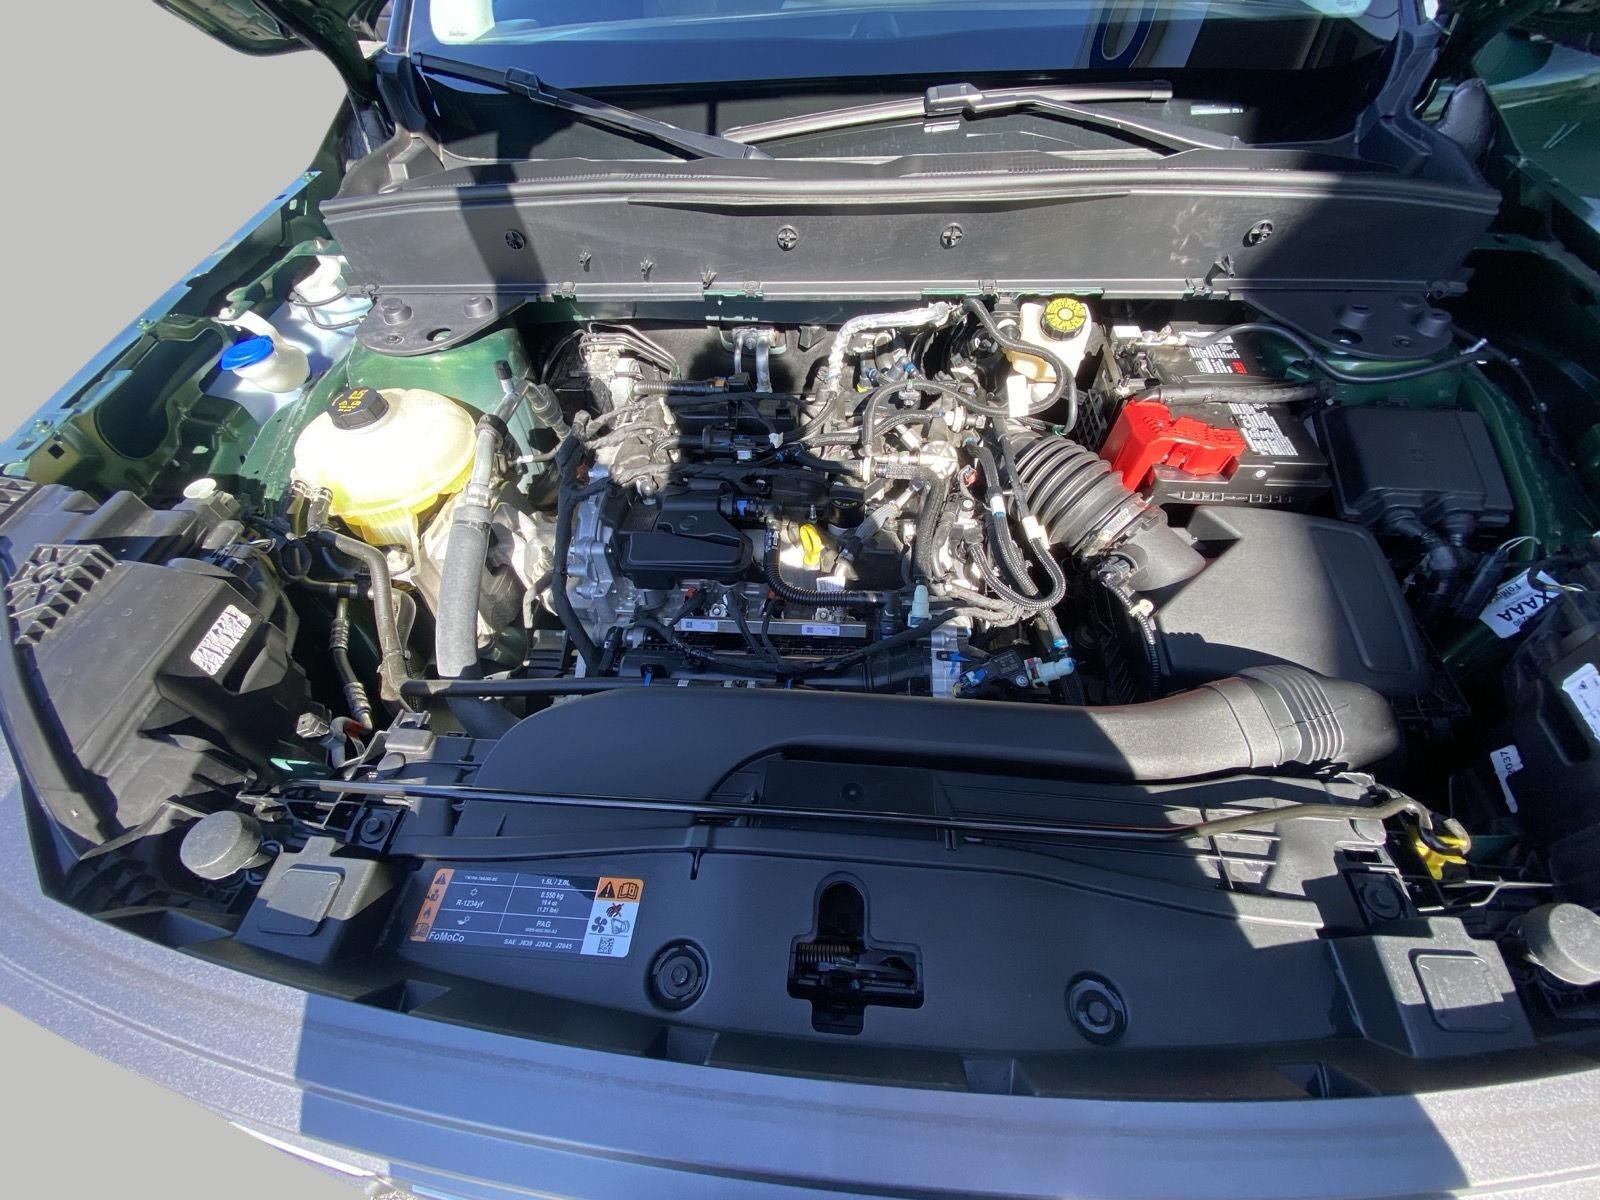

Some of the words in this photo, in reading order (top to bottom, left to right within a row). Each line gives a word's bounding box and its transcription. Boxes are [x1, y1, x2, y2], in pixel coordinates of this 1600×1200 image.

[1496, 588, 1552, 622] XAAA
[541, 878, 553, 886] 1.5L
[558, 878, 571, 886] 2.0L
[556, 892, 564, 901] kg
[456, 899, 484, 909] R-1234yf
[536, 920, 552, 928] PAG
[428, 931, 465, 943] FoMoCo
[503, 938, 516, 946] SAE
